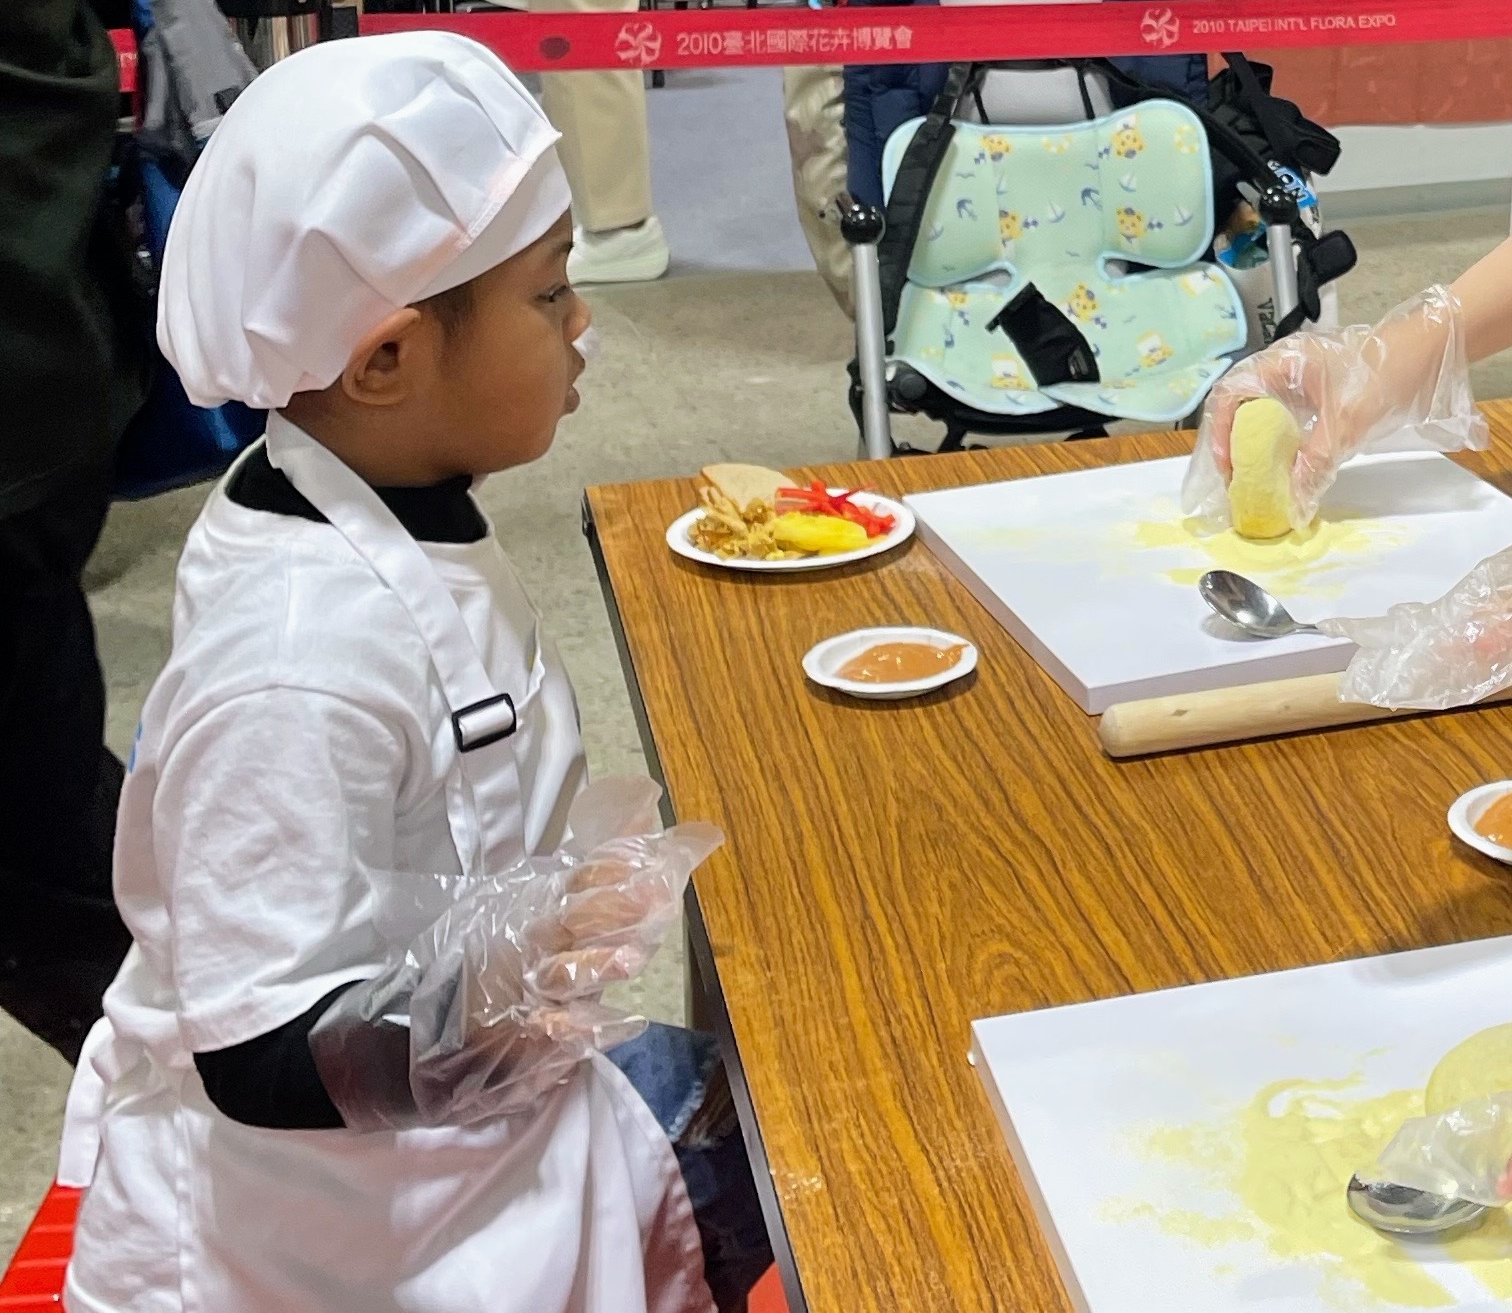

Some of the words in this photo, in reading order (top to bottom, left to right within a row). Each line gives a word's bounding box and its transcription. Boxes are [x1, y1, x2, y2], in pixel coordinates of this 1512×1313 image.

[1193, 20, 1224, 34] 2010
[1228, 18, 1272, 33] TAIPEI
[1310, 15, 1356, 30] FLORA
[1358, 14, 1396, 29] EXPO
[676, 25, 913, 55] 2010臺北國際花卉博覽會
